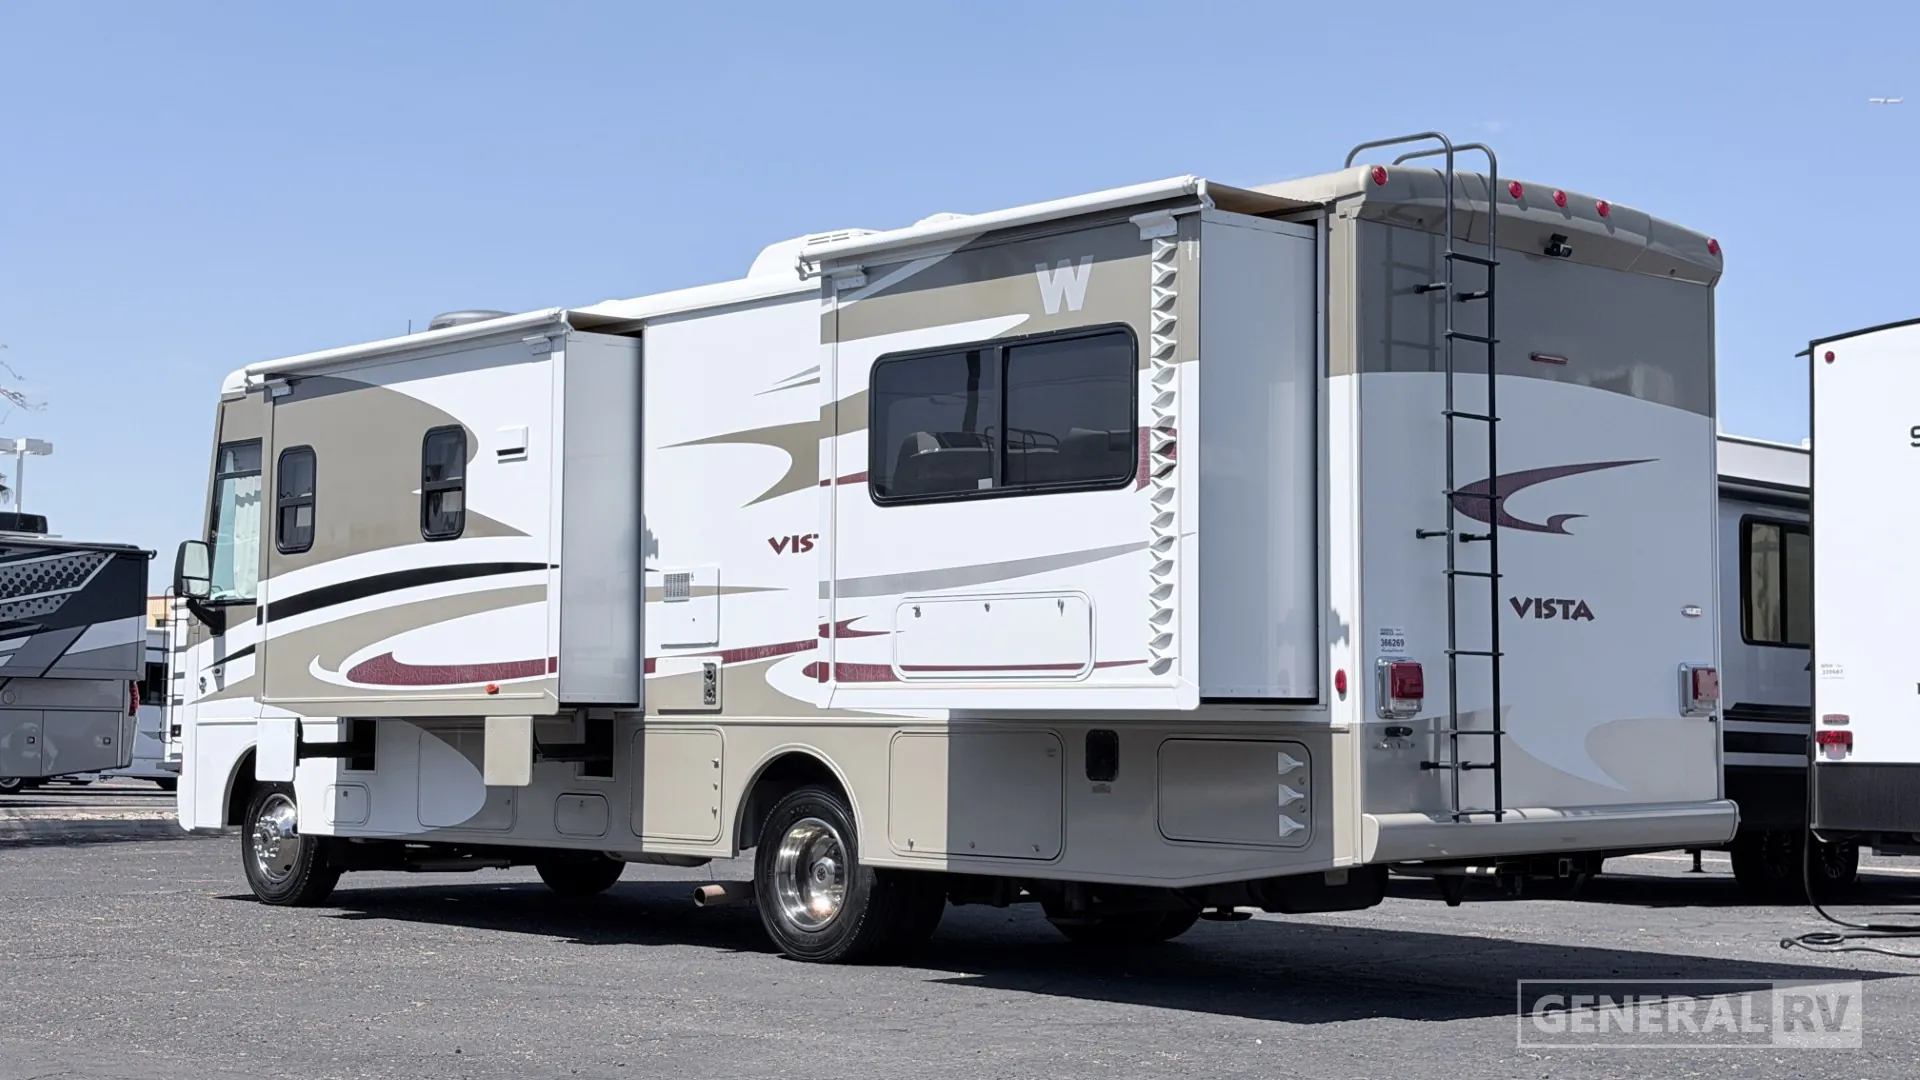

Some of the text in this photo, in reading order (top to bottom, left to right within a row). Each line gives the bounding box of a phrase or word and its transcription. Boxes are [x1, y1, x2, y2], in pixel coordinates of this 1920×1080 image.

[1034, 254, 1094, 316] W
[767, 533, 819, 555] VIS
[1508, 596, 1595, 622] VISTA
[1380, 638, 1405, 647] 366269
